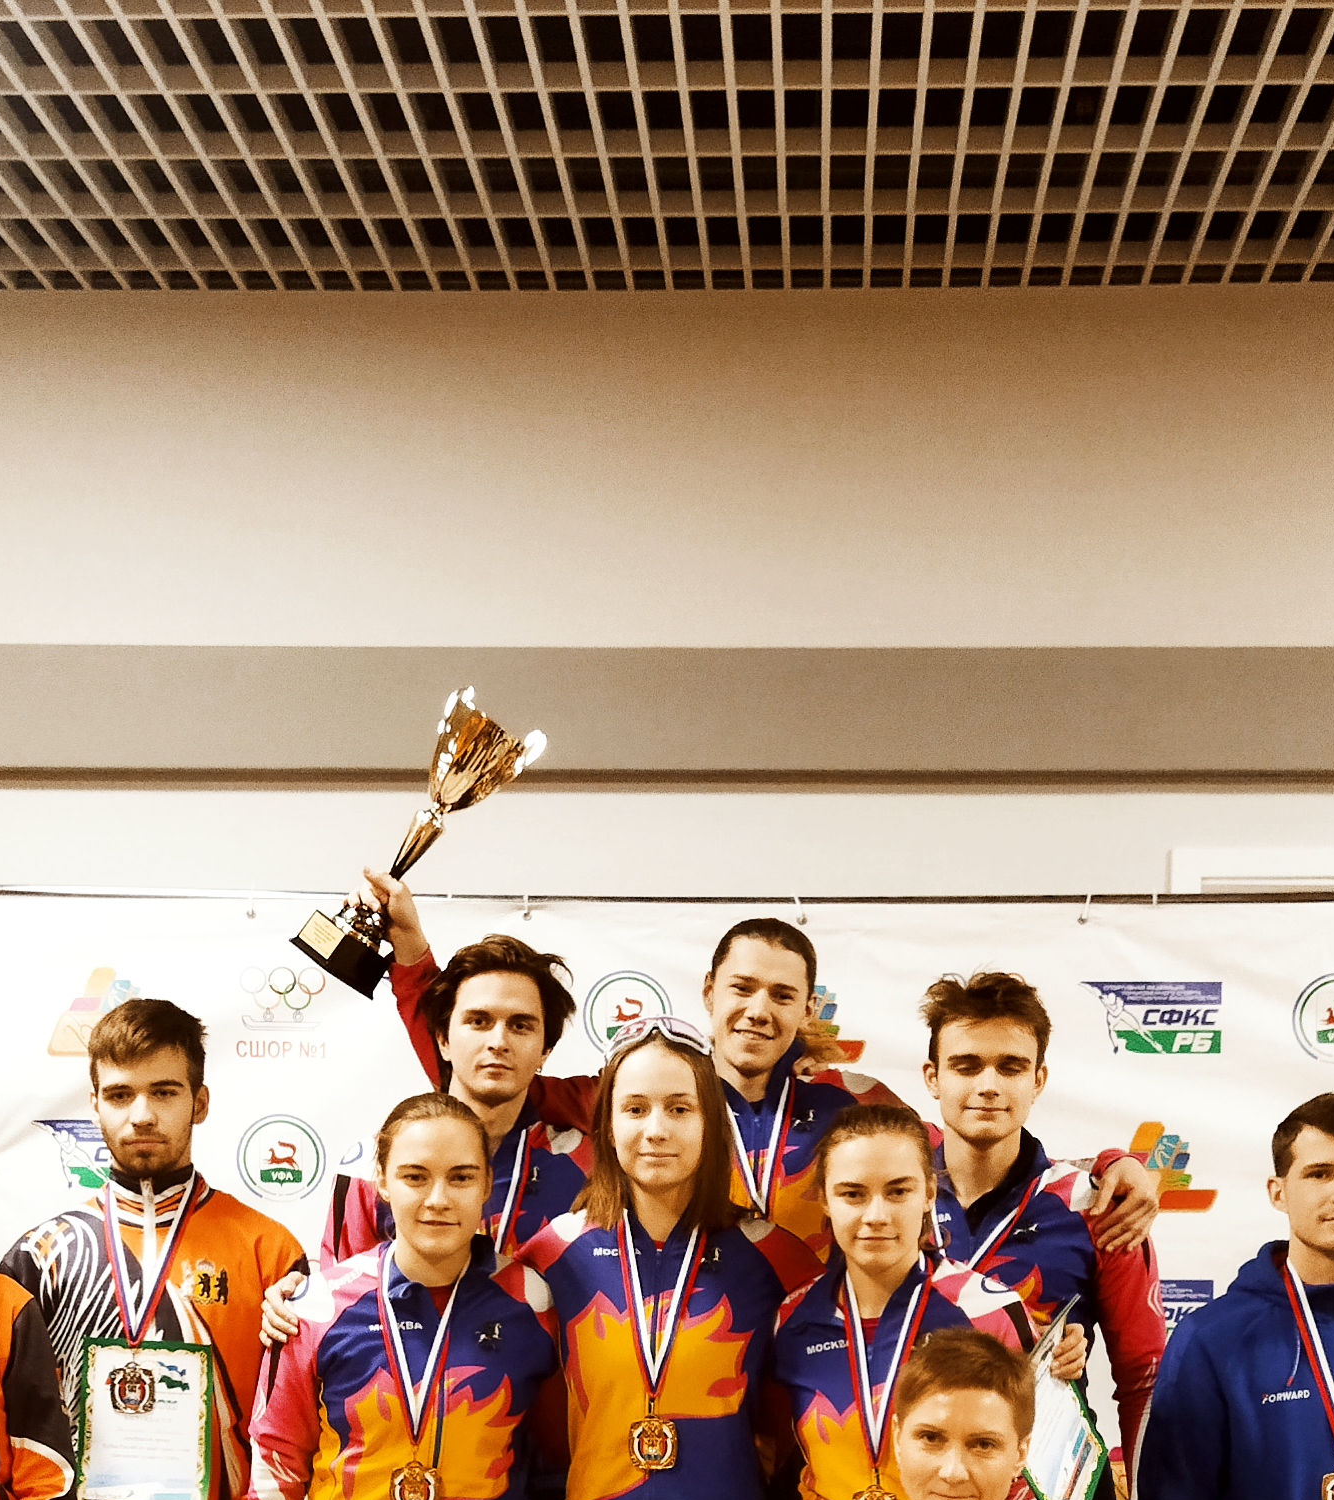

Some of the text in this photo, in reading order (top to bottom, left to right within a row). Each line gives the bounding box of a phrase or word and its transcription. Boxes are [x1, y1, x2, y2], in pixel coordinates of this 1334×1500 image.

[1142, 1009, 1219, 1025] СФКС
[236, 1040, 327, 1058] СШОР №1
[1172, 1032, 1214, 1053] РБ
[270, 1171, 294, 1181] УФА
[593, 1247, 642, 1257] МОСА
[369, 1321, 423, 1331] МКВА
[1261, 1389, 1310, 1404] FORWARD
